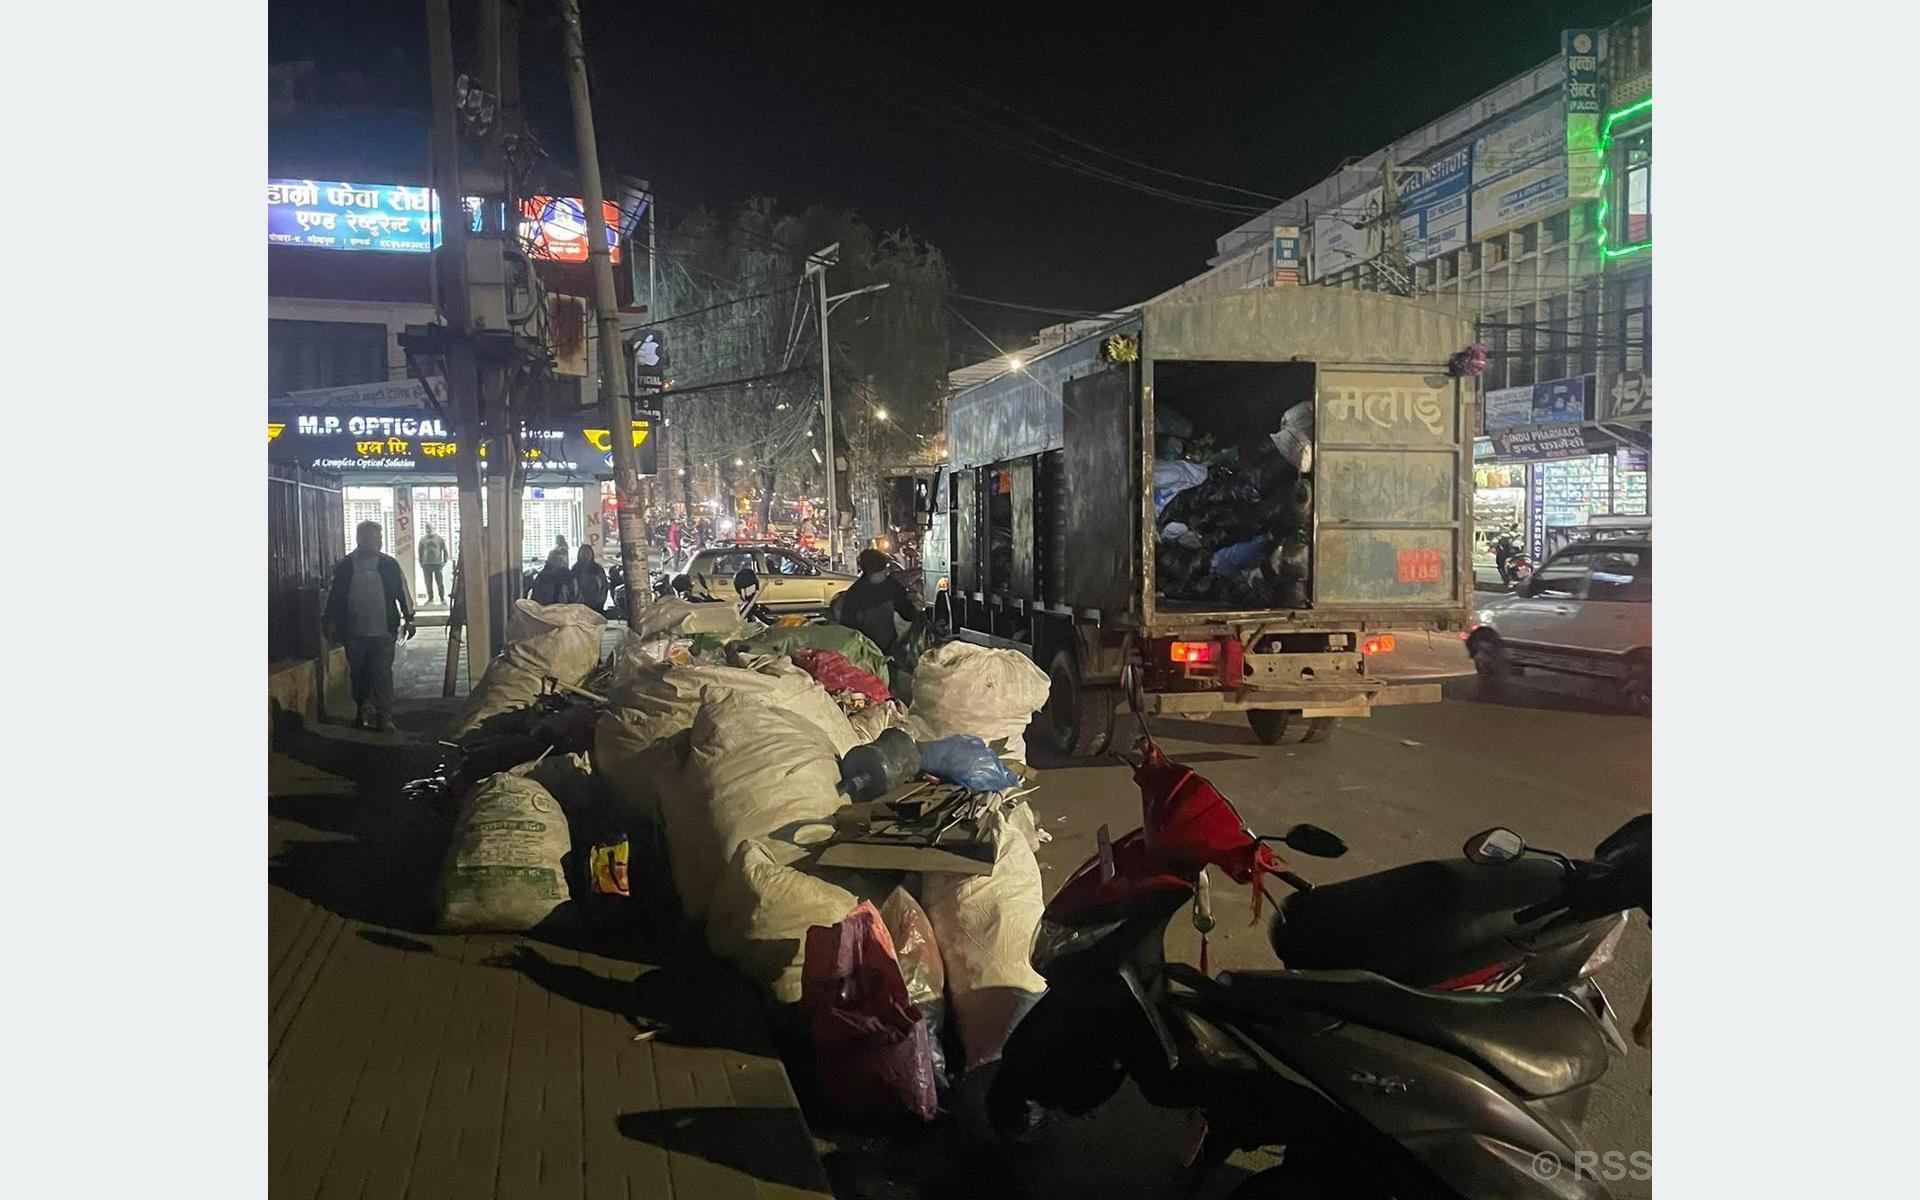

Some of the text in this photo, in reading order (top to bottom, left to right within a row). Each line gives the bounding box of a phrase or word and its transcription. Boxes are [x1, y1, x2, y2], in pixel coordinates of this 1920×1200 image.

[298, 415, 447, 436] M.P. OPTICAL
[1531, 426, 1582, 442] PHARMACY
[356, 457, 385, 469] Optical
[384, 458, 415, 468] Solution
[1534, 507, 1543, 558] PHARMACY
